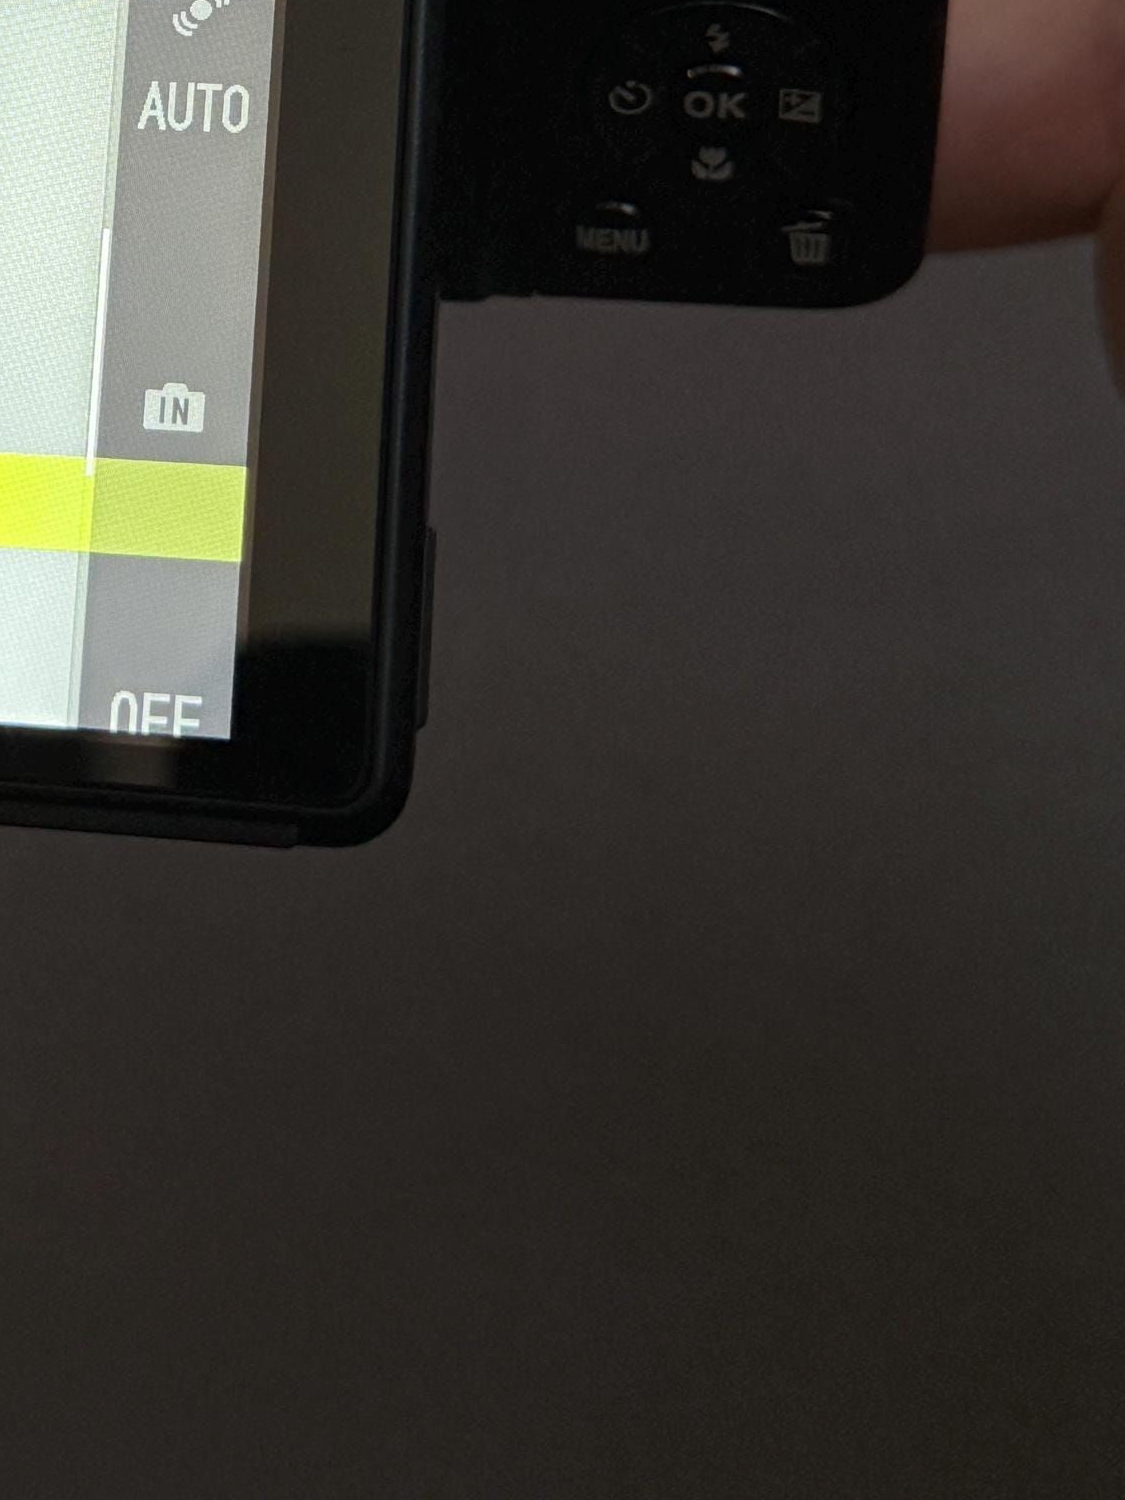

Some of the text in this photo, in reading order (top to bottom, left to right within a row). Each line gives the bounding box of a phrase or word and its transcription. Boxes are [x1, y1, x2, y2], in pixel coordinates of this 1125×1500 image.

[138, 80, 251, 134] AUTO
[683, 91, 747, 121] OK
[575, 225, 651, 255] MENU
[158, 396, 190, 426] IN
[108, 690, 203, 738] OFF
